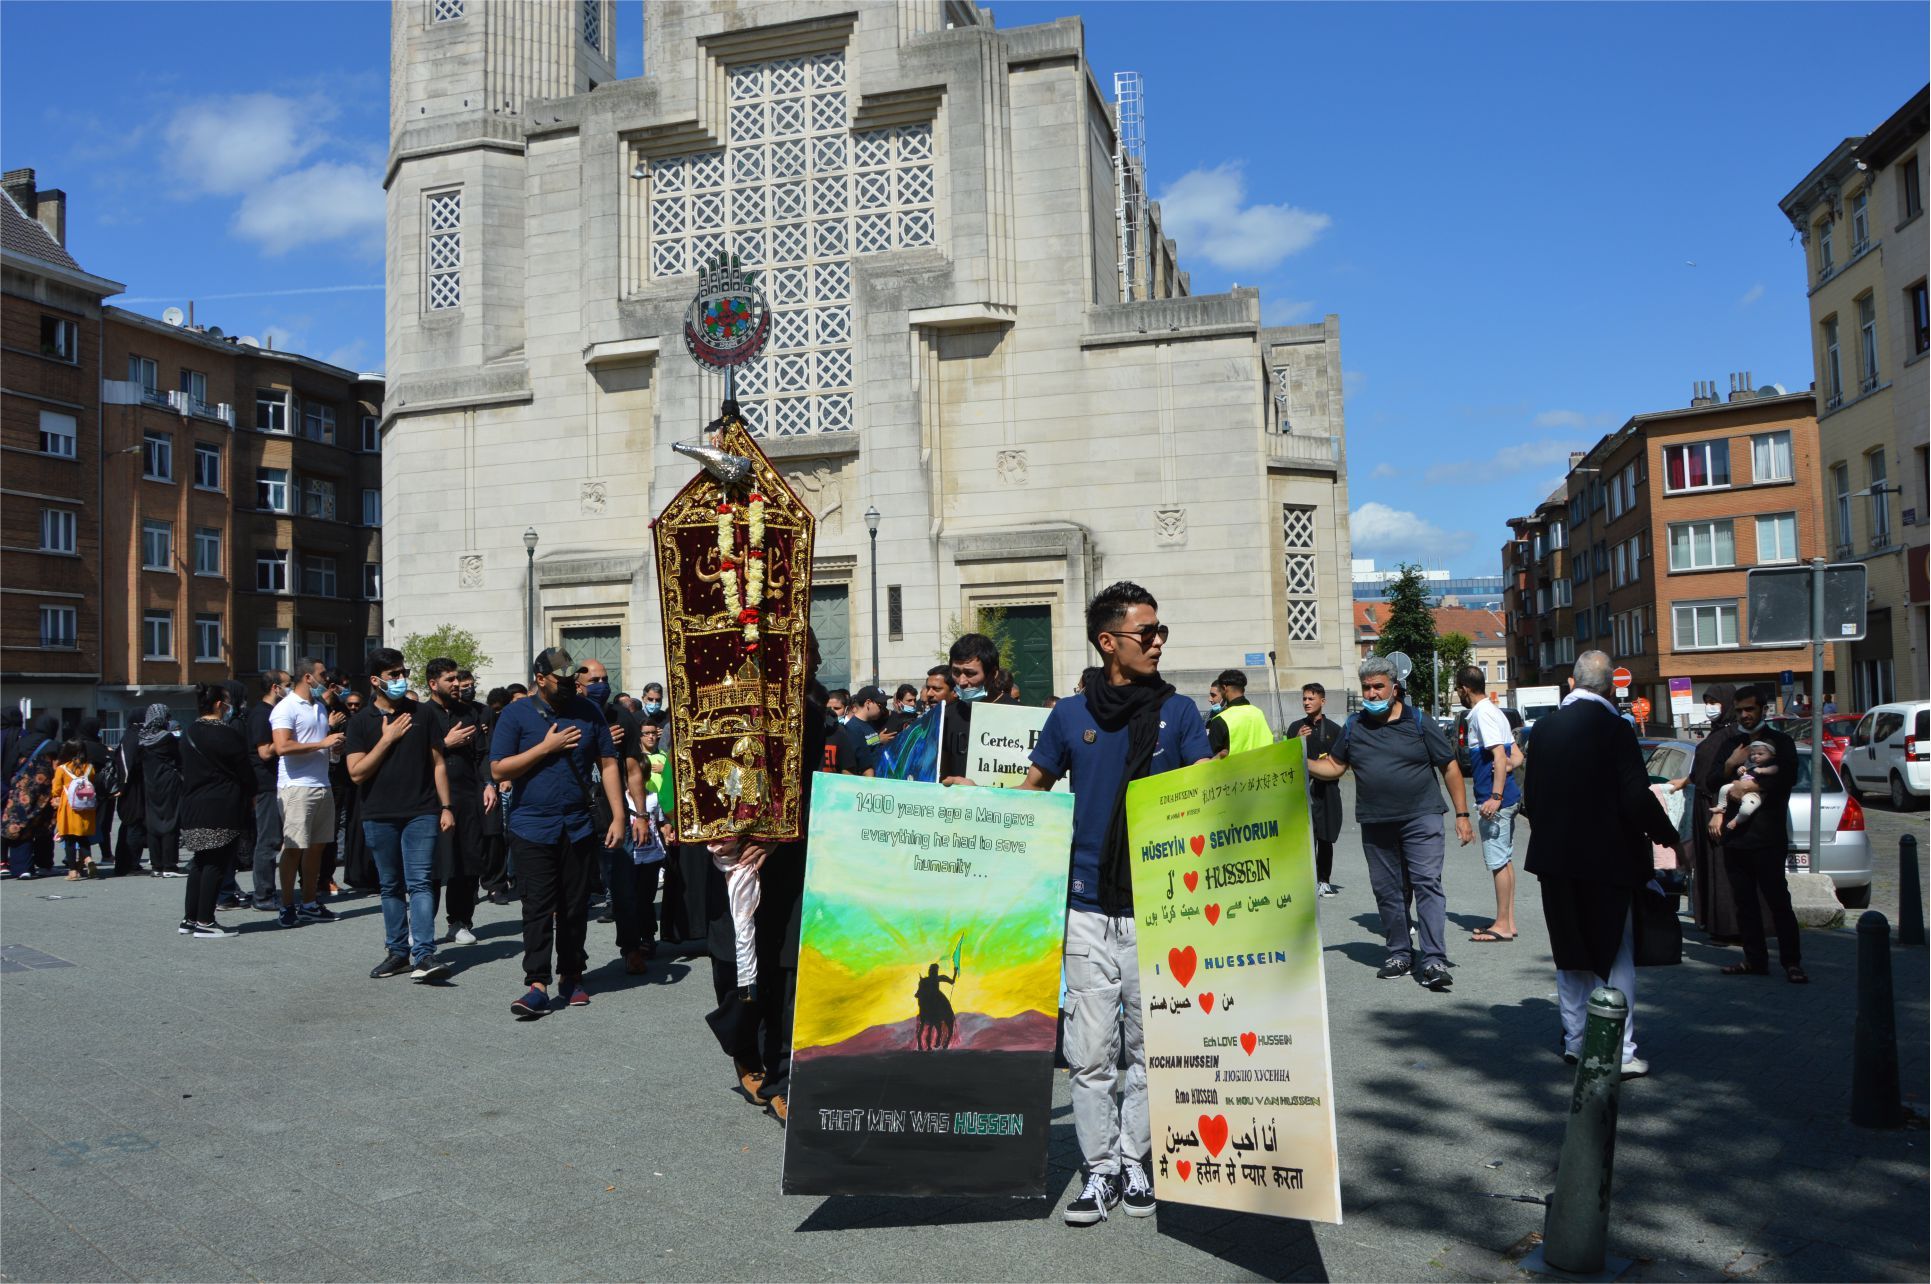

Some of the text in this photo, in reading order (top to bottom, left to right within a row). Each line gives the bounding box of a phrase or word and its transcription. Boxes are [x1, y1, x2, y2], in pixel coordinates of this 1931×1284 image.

[980, 731, 1024, 752] Certes,
[977, 757, 1030, 776] la lanter
[856, 792, 1035, 828] 1400 years ago a Man gave
[861, 828, 1027, 853] everything he had to save
[1141, 819, 1279, 862] HÜSEYİN SEVİYORUM
[1205, 858, 1271, 890] HUSSEIN
[1155, 951, 1286, 975] I HUESSEIN
[1222, 993, 1234, 1011] من
[1203, 1034, 1293, 1048] Ech LOVE HUSSEIN
[1183, 1055, 1219, 1069] HUSSEIN
[1214, 1070, 1221, 1082] Я
[1236, 1096, 1254, 1106] HOU
[1254, 1096, 1279, 1106] VAN
[1280, 1096, 1321, 1107] HUSSEIN
[818, 1108, 1024, 1135] THAT MAN WAS HUSSEIN
[1231, 1117, 1259, 1159] أحب
[1262, 1117, 1278, 1152] أنا
[1240, 1163, 1268, 1188] प्यार
[1271, 1165, 1304, 1190] करता
